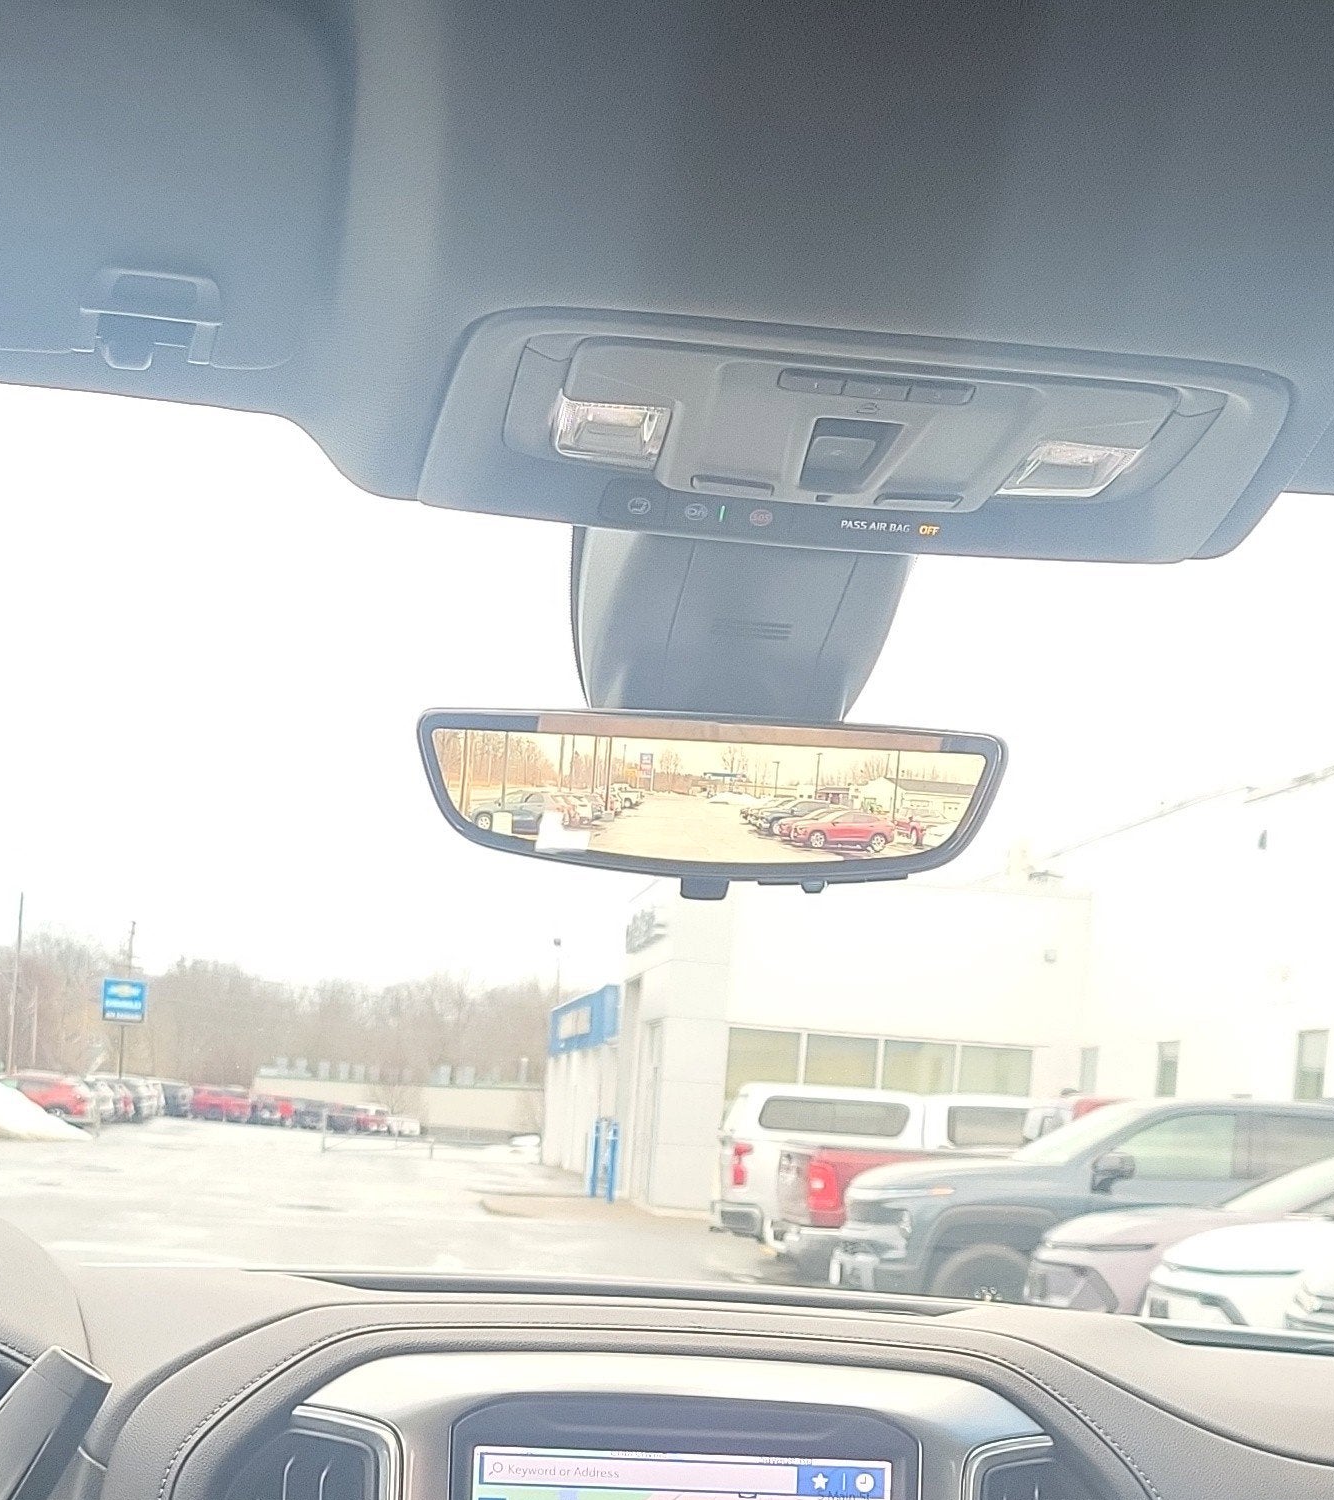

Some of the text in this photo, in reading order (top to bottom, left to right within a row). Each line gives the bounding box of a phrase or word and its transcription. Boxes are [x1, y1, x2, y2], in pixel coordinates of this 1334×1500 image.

[841, 519, 940, 536] PASS AIR BAG OFF
[508, 1463, 620, 1479] Keyword or Address
